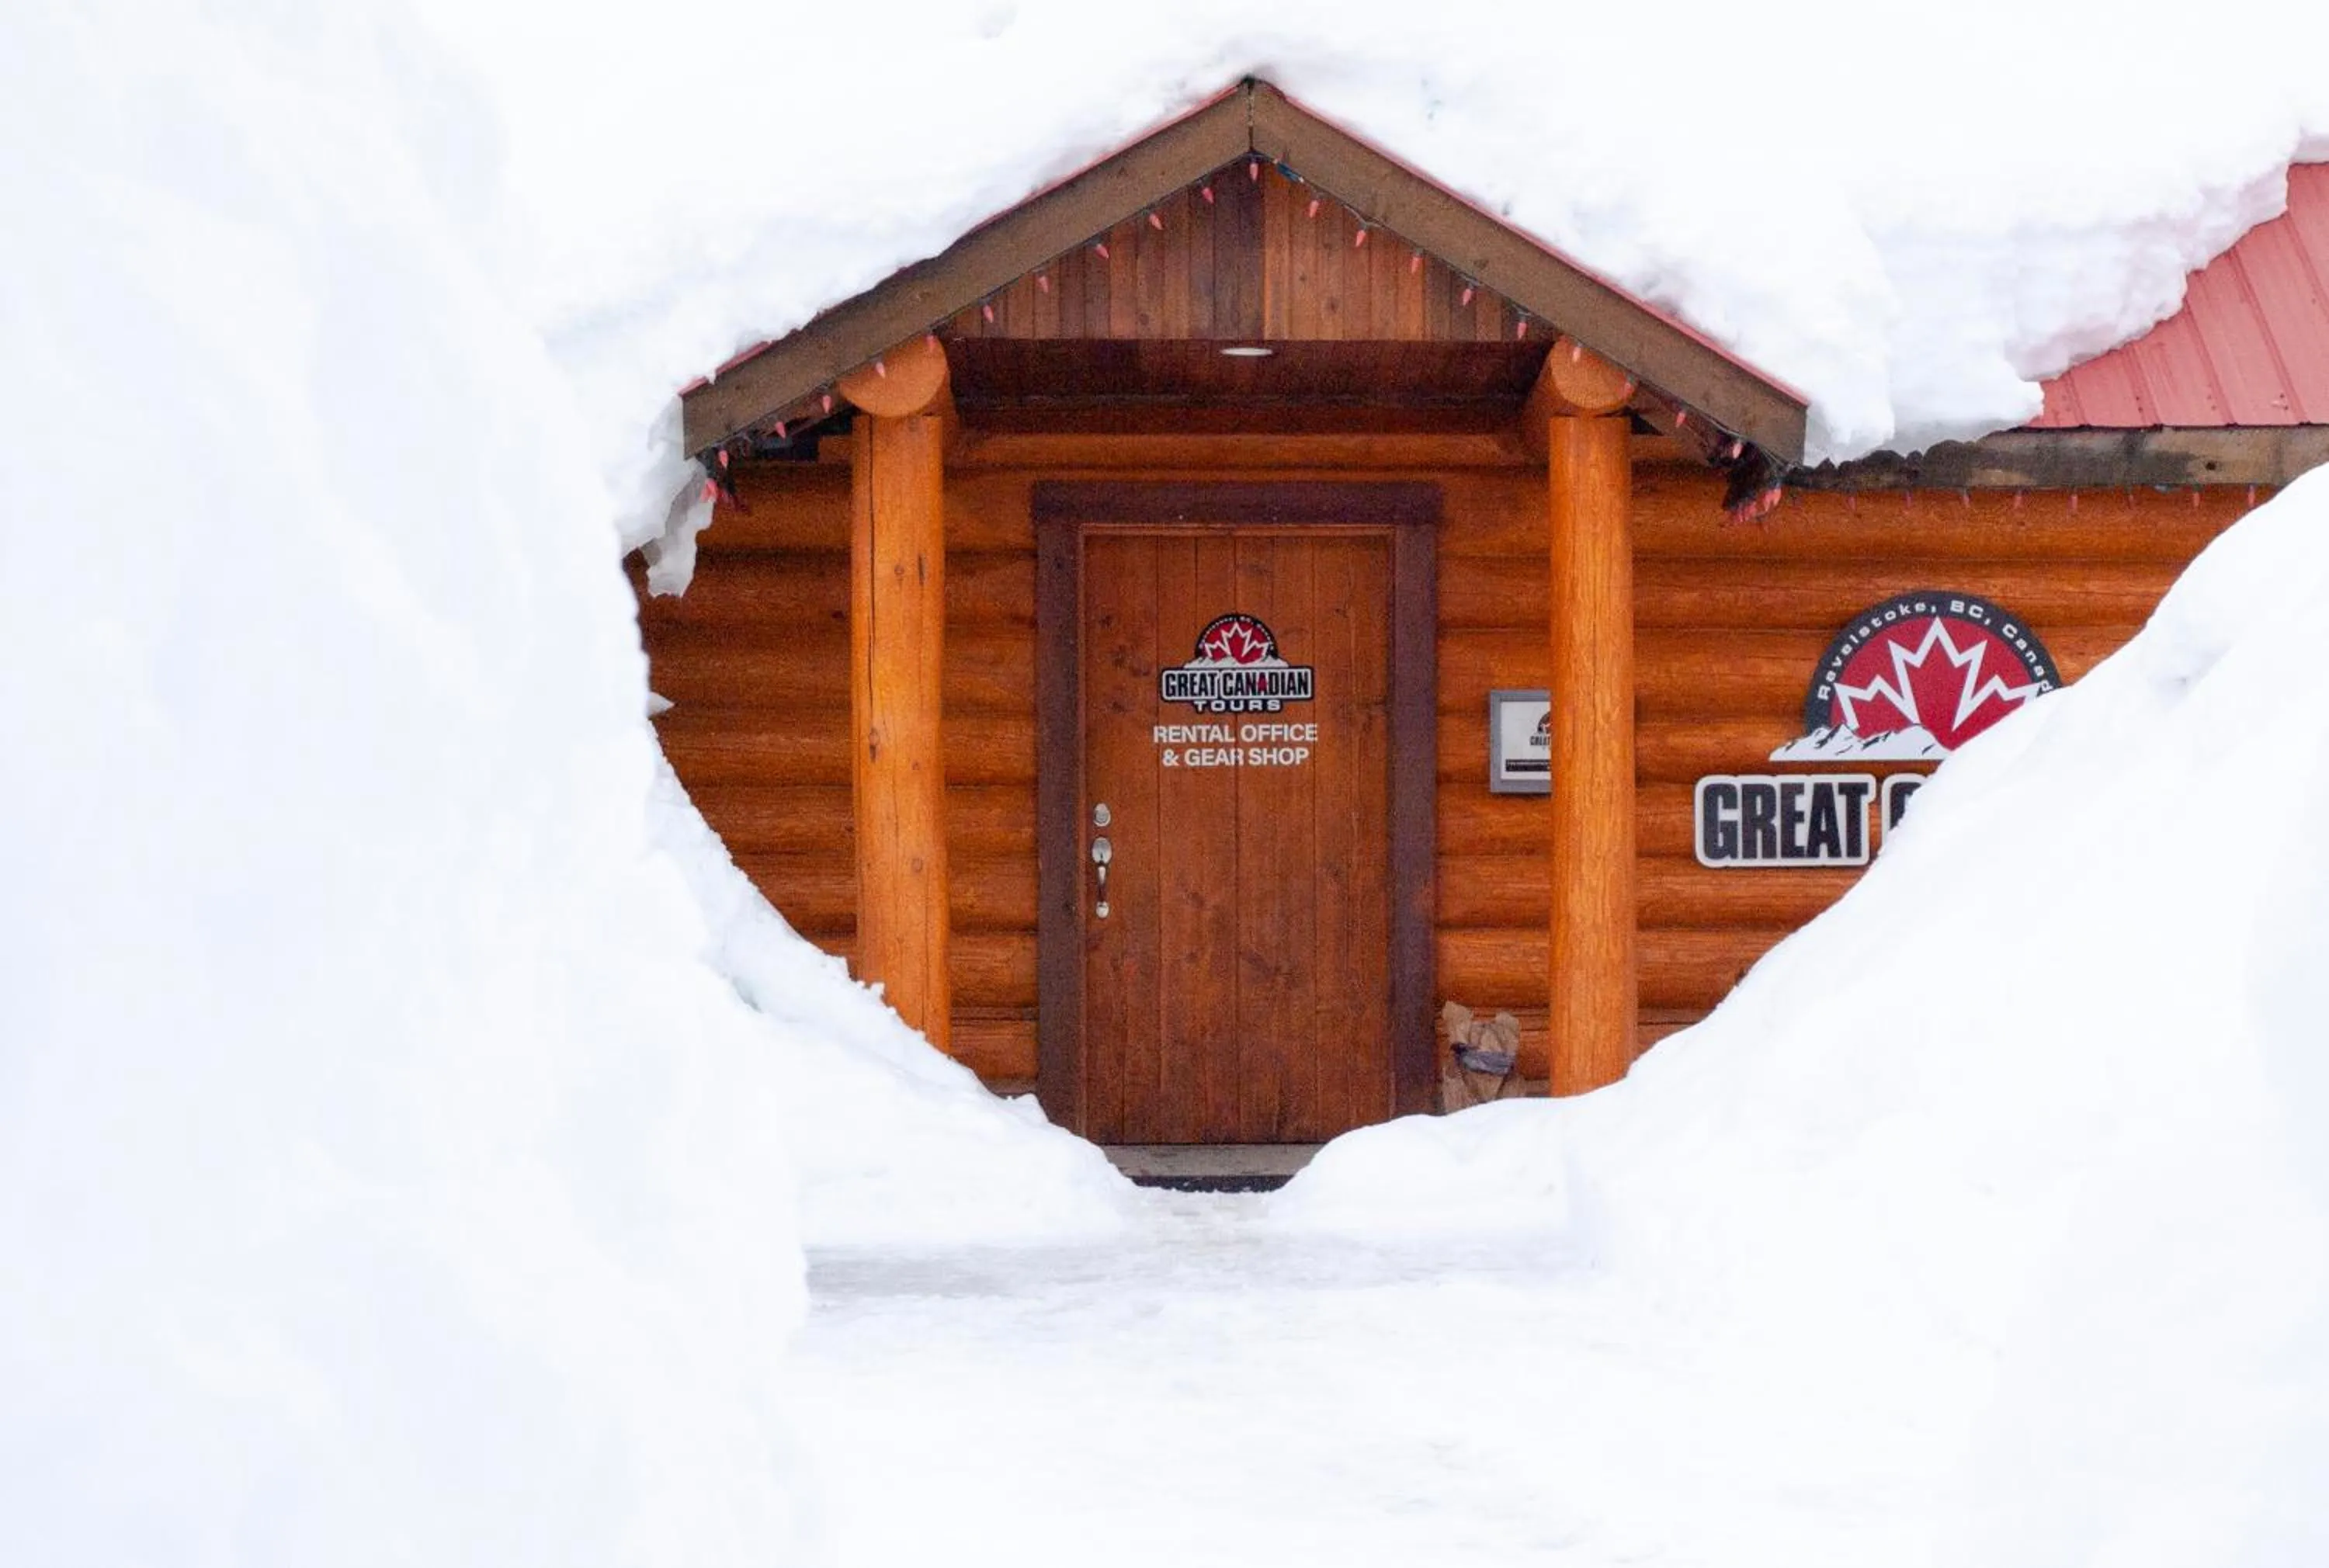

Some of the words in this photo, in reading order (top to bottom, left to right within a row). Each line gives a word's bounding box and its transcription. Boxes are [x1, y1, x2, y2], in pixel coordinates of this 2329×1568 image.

[1817, 602, 1937, 701] Revelstoke,
[1949, 599, 1991, 626] BC,
[1164, 671, 1219, 698] GREAT
[1222, 671, 1309, 696] CANADIAN
[1194, 700, 1281, 712] TOURS
[1153, 724, 1235, 744] RENTAL
[1241, 723, 1318, 743] OFFICE
[1162, 748, 1179, 767] &
[1185, 748, 1244, 767] GEAR
[1248, 747, 1310, 766] SHOP
[1702, 782, 1869, 860] GREAT
